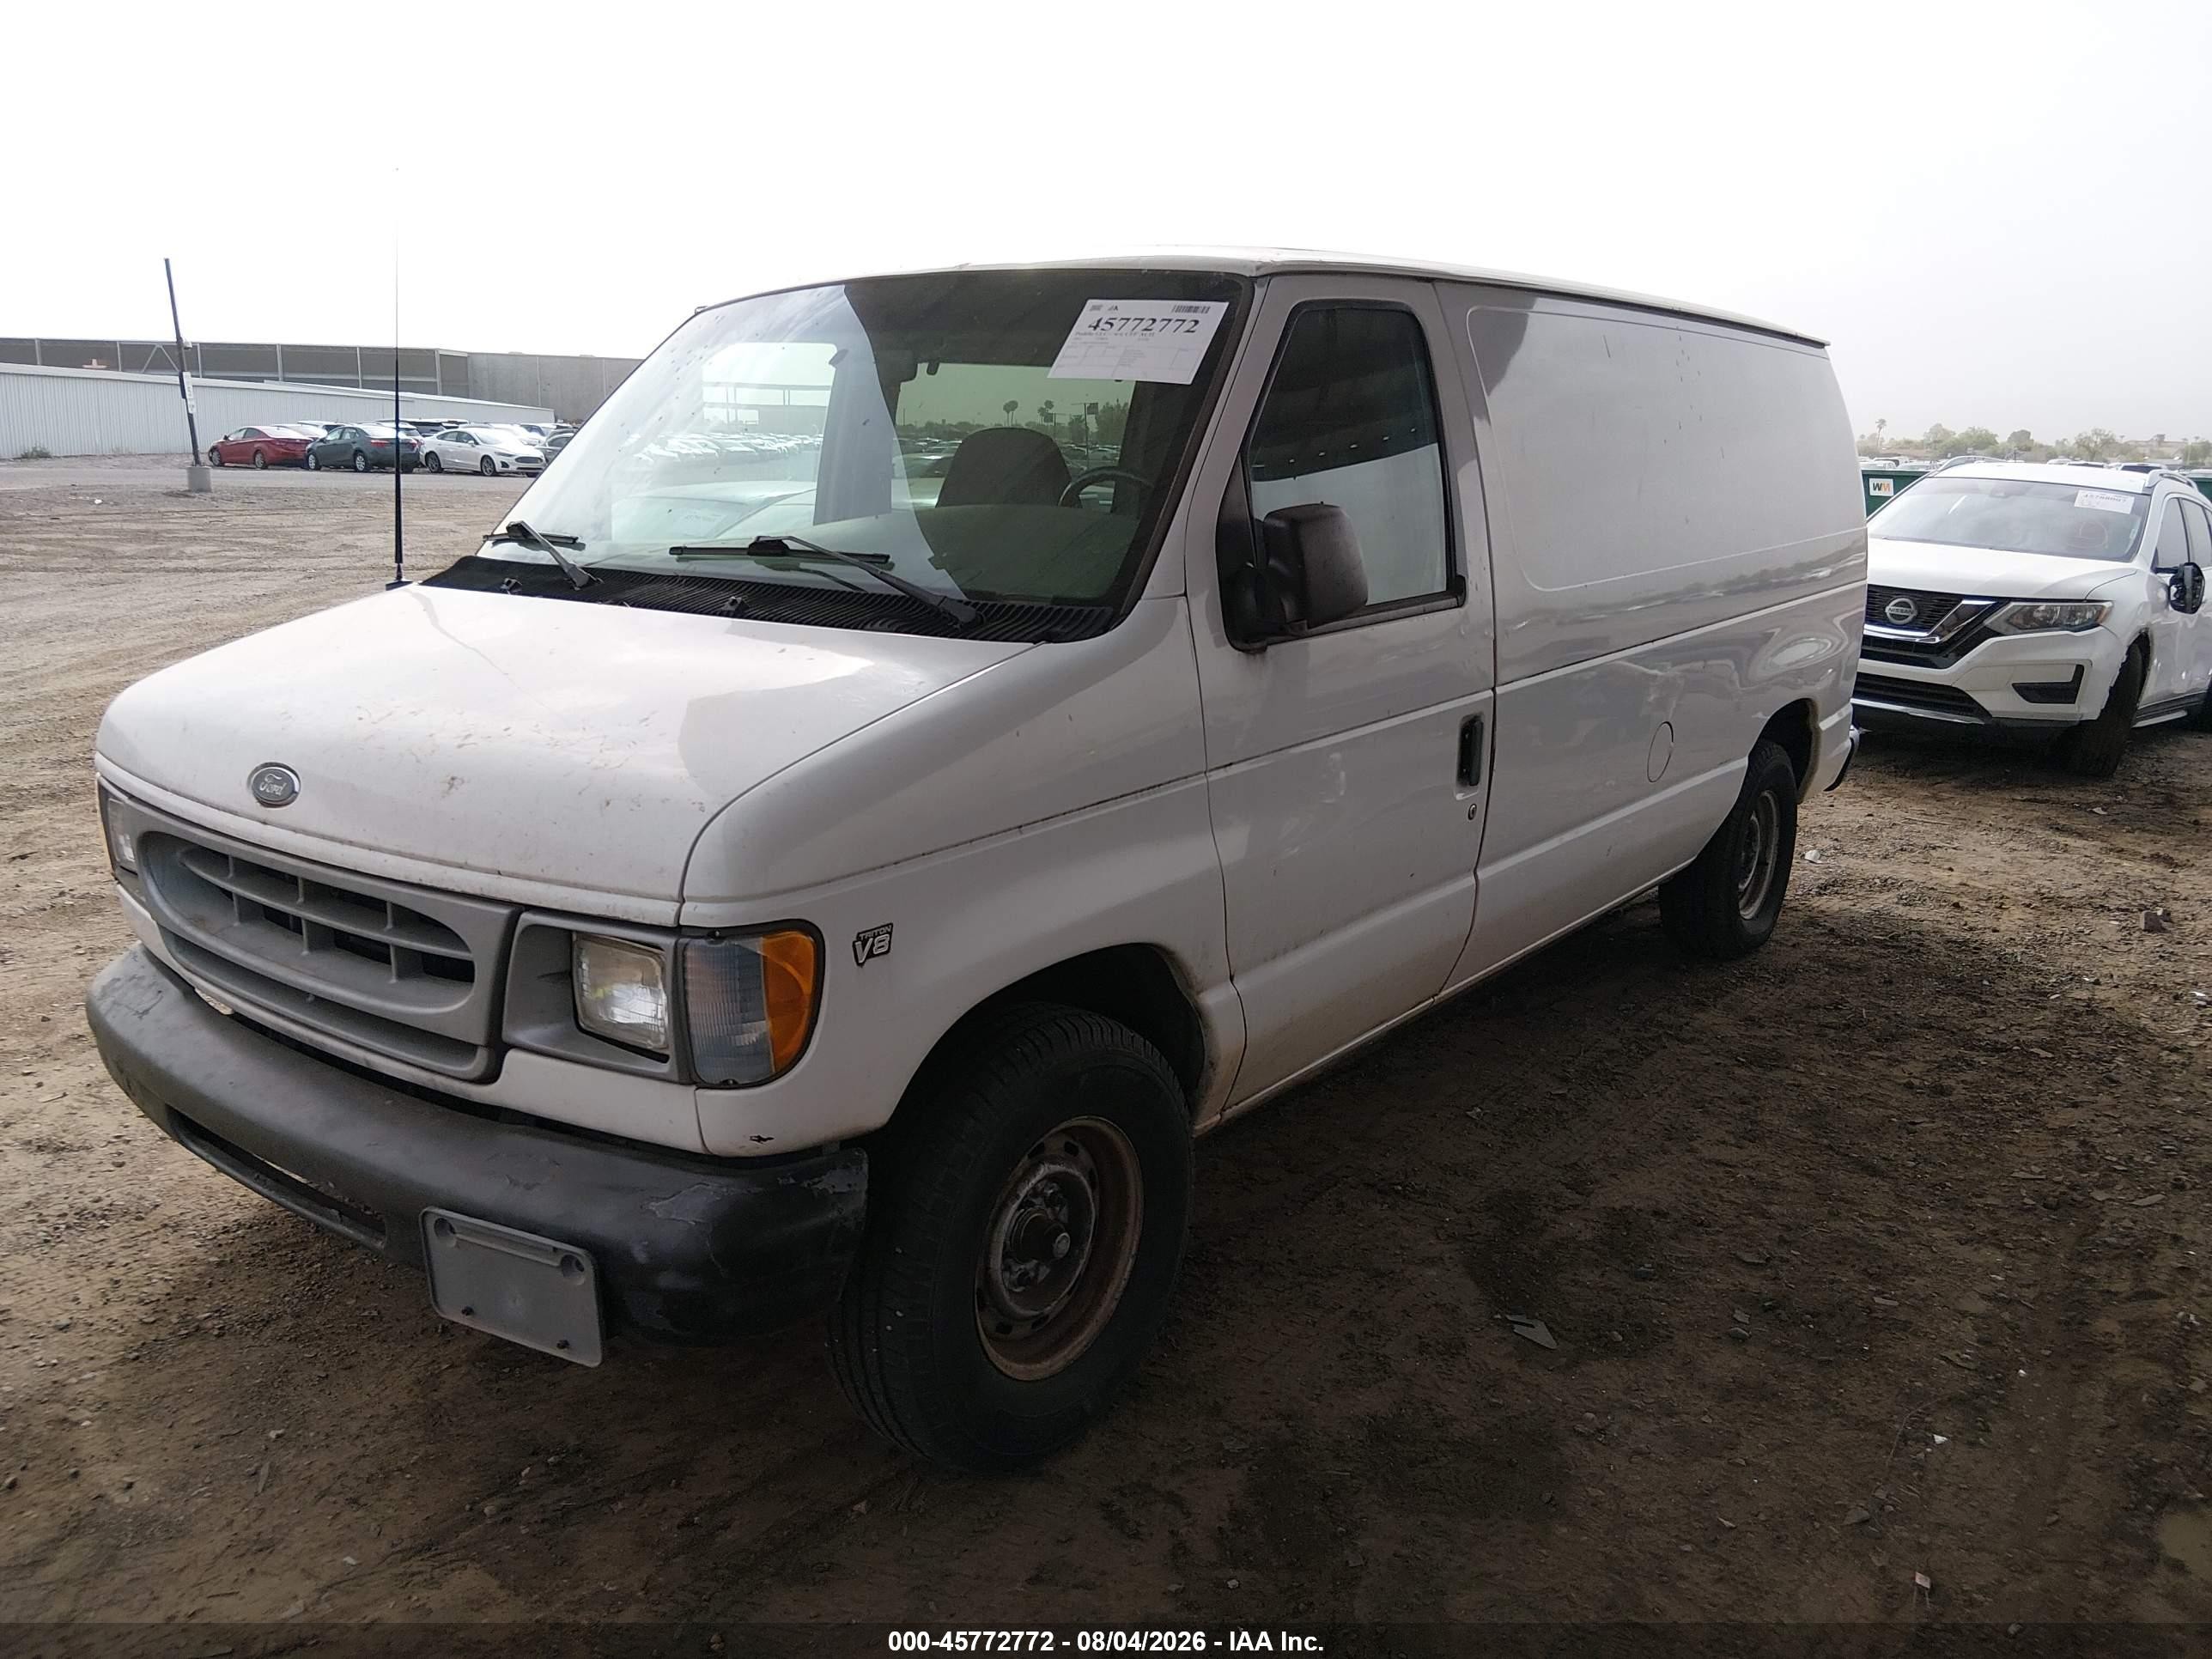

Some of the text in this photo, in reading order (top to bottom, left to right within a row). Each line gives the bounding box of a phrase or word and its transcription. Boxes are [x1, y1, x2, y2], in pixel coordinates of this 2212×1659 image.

[1087, 317, 1200, 333] 45772772
[259, 773, 287, 796] Ford
[859, 924, 891, 941] TRITON
[854, 933, 890, 963] V8
